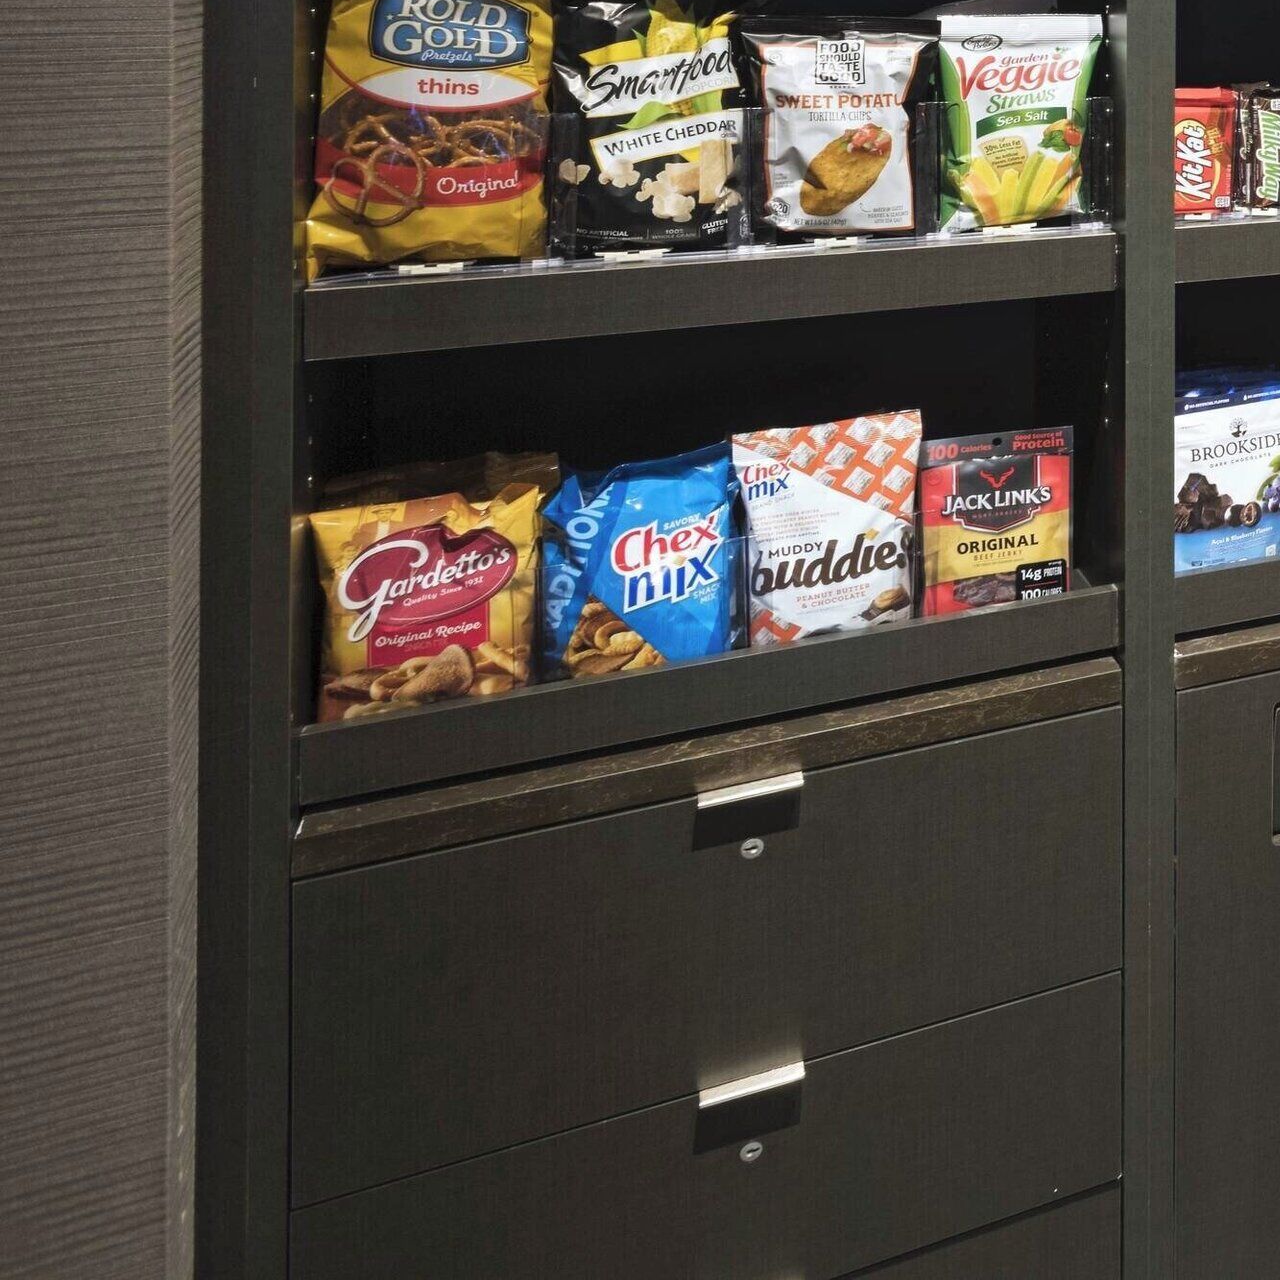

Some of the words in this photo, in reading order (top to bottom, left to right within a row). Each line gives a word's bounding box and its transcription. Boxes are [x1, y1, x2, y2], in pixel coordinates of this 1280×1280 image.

[383, 19, 519, 59] GOLD
[820, 42, 861, 53] FOOD
[421, 49, 472, 63] Pretzels
[999, 54, 1049, 68] garden
[585, 39, 734, 111] Smartfood
[955, 56, 1080, 101] Veggie
[417, 78, 480, 96] thins
[985, 89, 1056, 114] Straws
[996, 115, 1021, 127] Sea
[1024, 109, 1049, 121] Salt
[604, 132, 662, 156] WHITE
[665, 120, 737, 141] CHEDDAR
[437, 175, 519, 198] Original
[928, 443, 959, 461] 100
[1012, 437, 1065, 451] Protein
[1209, 460, 1229, 468] DARK
[1230, 452, 1272, 465] CHOCOLATE
[743, 459, 792, 485] Chex
[747, 472, 791, 501] mix
[941, 493, 993, 515] JACK
[994, 486, 1052, 508] LINK'S
[613, 515, 719, 572] Chex
[768, 541, 824, 559] MUDDY
[957, 533, 1039, 555] ORIGINAL
[627, 543, 718, 609] mix
[1020, 569, 1042, 581] 14g
[337, 539, 512, 642] Gardetto's
[796, 589, 833, 603] PEANUT
[836, 583, 871, 595] BUTTER
[810, 591, 868, 608] CHOCOLATE
[375, 631, 433, 648] Original
[435, 621, 482, 637] Recipe
